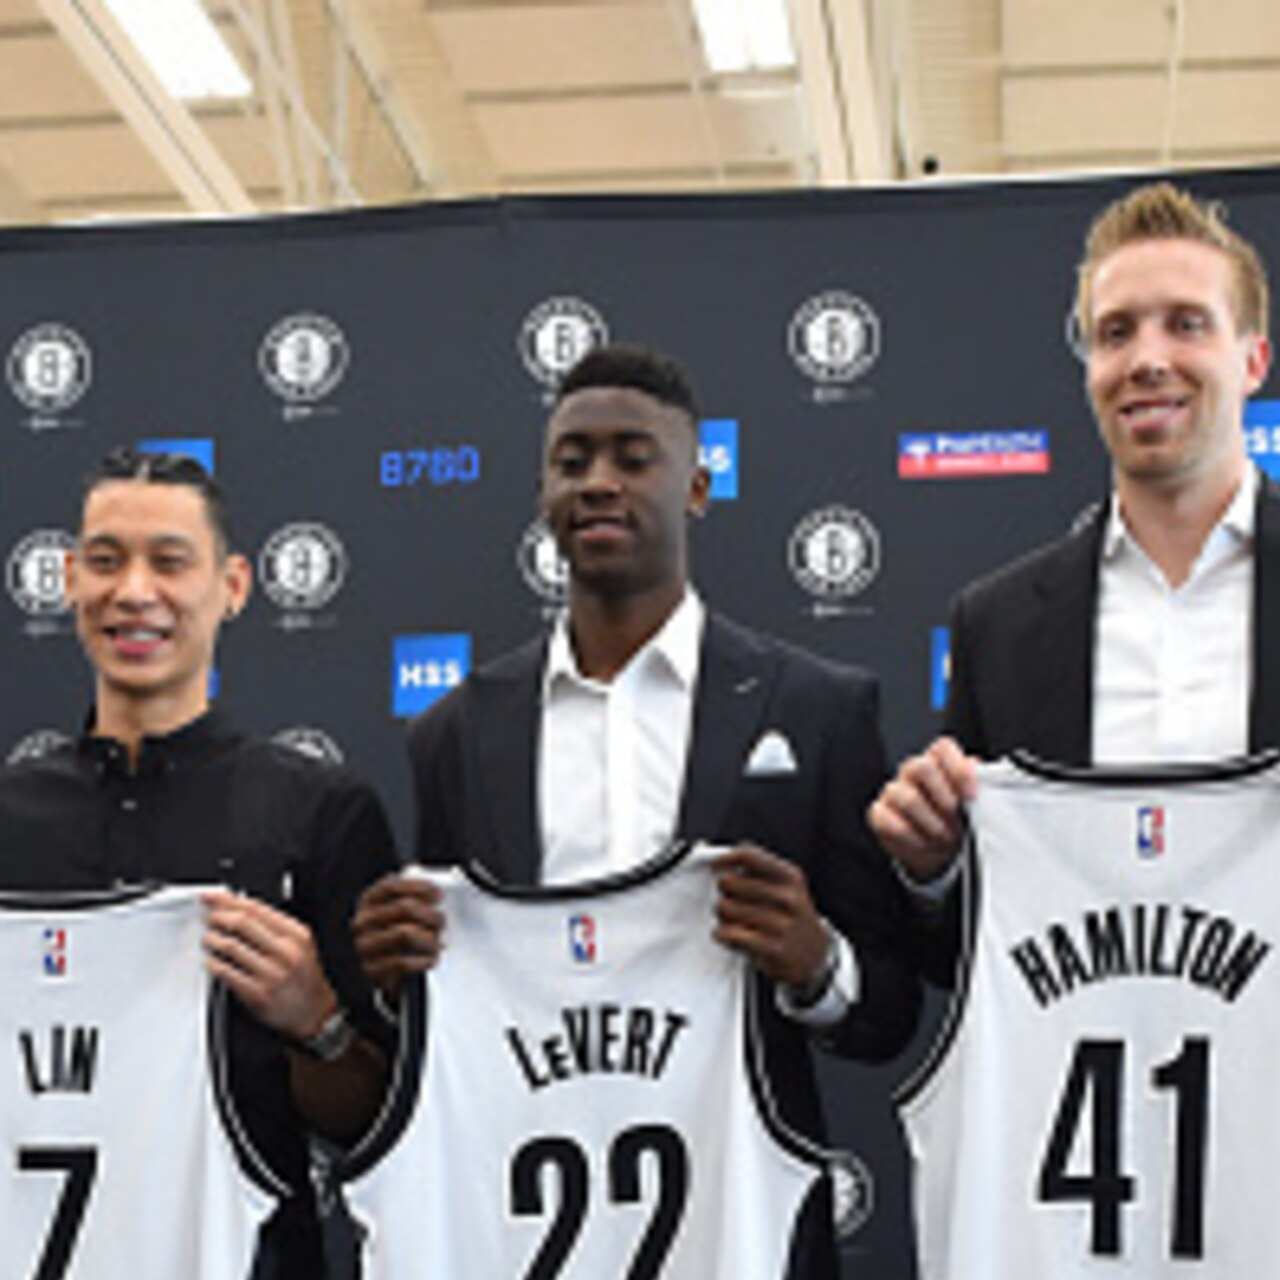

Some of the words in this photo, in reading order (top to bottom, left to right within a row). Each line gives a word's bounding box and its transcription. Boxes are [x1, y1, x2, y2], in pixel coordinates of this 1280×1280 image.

[399, 661, 462, 688] HSS
[1010, 904, 1271, 1008] HAMILTON
[19, 1026, 99, 1095] LIN
[1037, 1036, 1211, 1261] 41
